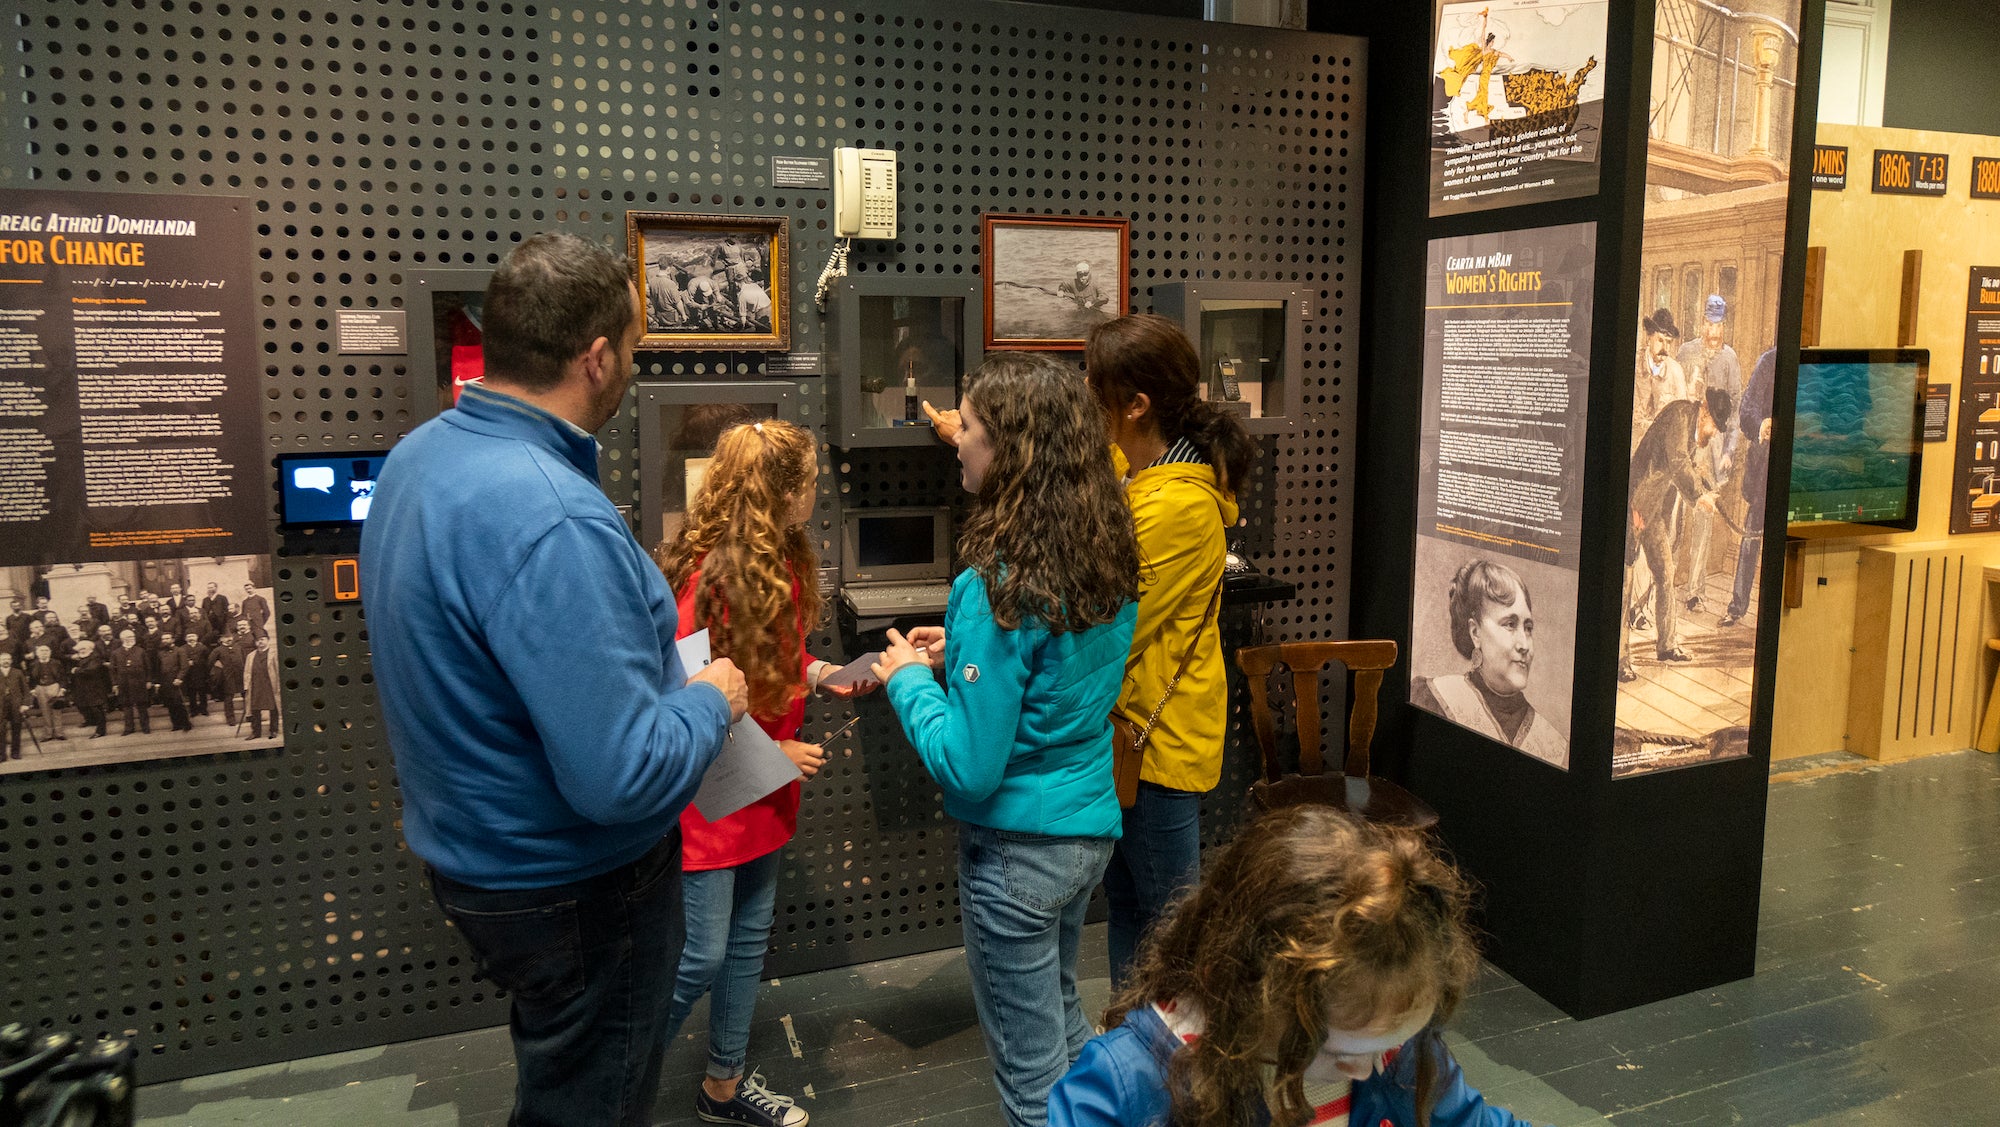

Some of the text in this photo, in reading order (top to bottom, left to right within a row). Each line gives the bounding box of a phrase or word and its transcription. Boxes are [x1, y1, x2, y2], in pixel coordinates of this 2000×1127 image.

[1473, 139, 1489, 149] there
[1490, 137, 1501, 146] will
[1502, 135, 1510, 143] be
[1516, 129, 1537, 142] golden
[1539, 125, 1556, 136] cable
[1558, 123, 1566, 132] of
[1444, 154, 1471, 167] sympathy
[1471, 149, 1495, 160] between
[1496, 148, 1508, 156] you
[1509, 144, 1521, 153] and
[1547, 136, 1563, 145] work
[1565, 133, 1576, 142] not
[1444, 168, 1455, 178] only
[1456, 166, 1464, 174] for
[1465, 164, 1474, 172] the
[1476, 162, 1496, 170] women
[1505, 158, 1519, 167] your
[1547, 149, 1558, 158] but
[1559, 147, 1569, 155] for
[1570, 145, 1582, 153] the
[1819, 149, 1845, 175] MINS
[1443, 179, 1463, 187] women
[1471, 174, 1480, 182] the
[1482, 171, 1499, 180] whole
[1828, 176, 1843, 184] word
[1879, 153, 1910, 188] 1860s
[1920, 156, 1945, 180] 7-13
[1502, 184, 1518, 192] Council
[1915, 181, 1928, 189] Words
[46, 213, 101, 233] ATHRÚ
[106, 214, 196, 236] DOMHANDA
[0, 235, 145, 266] FOR CHANGE
[1446, 256, 1474, 270] CEARTA
[1475, 256, 1485, 268] NA
[1446, 269, 1542, 294] WOMEN'S RIGHTS
